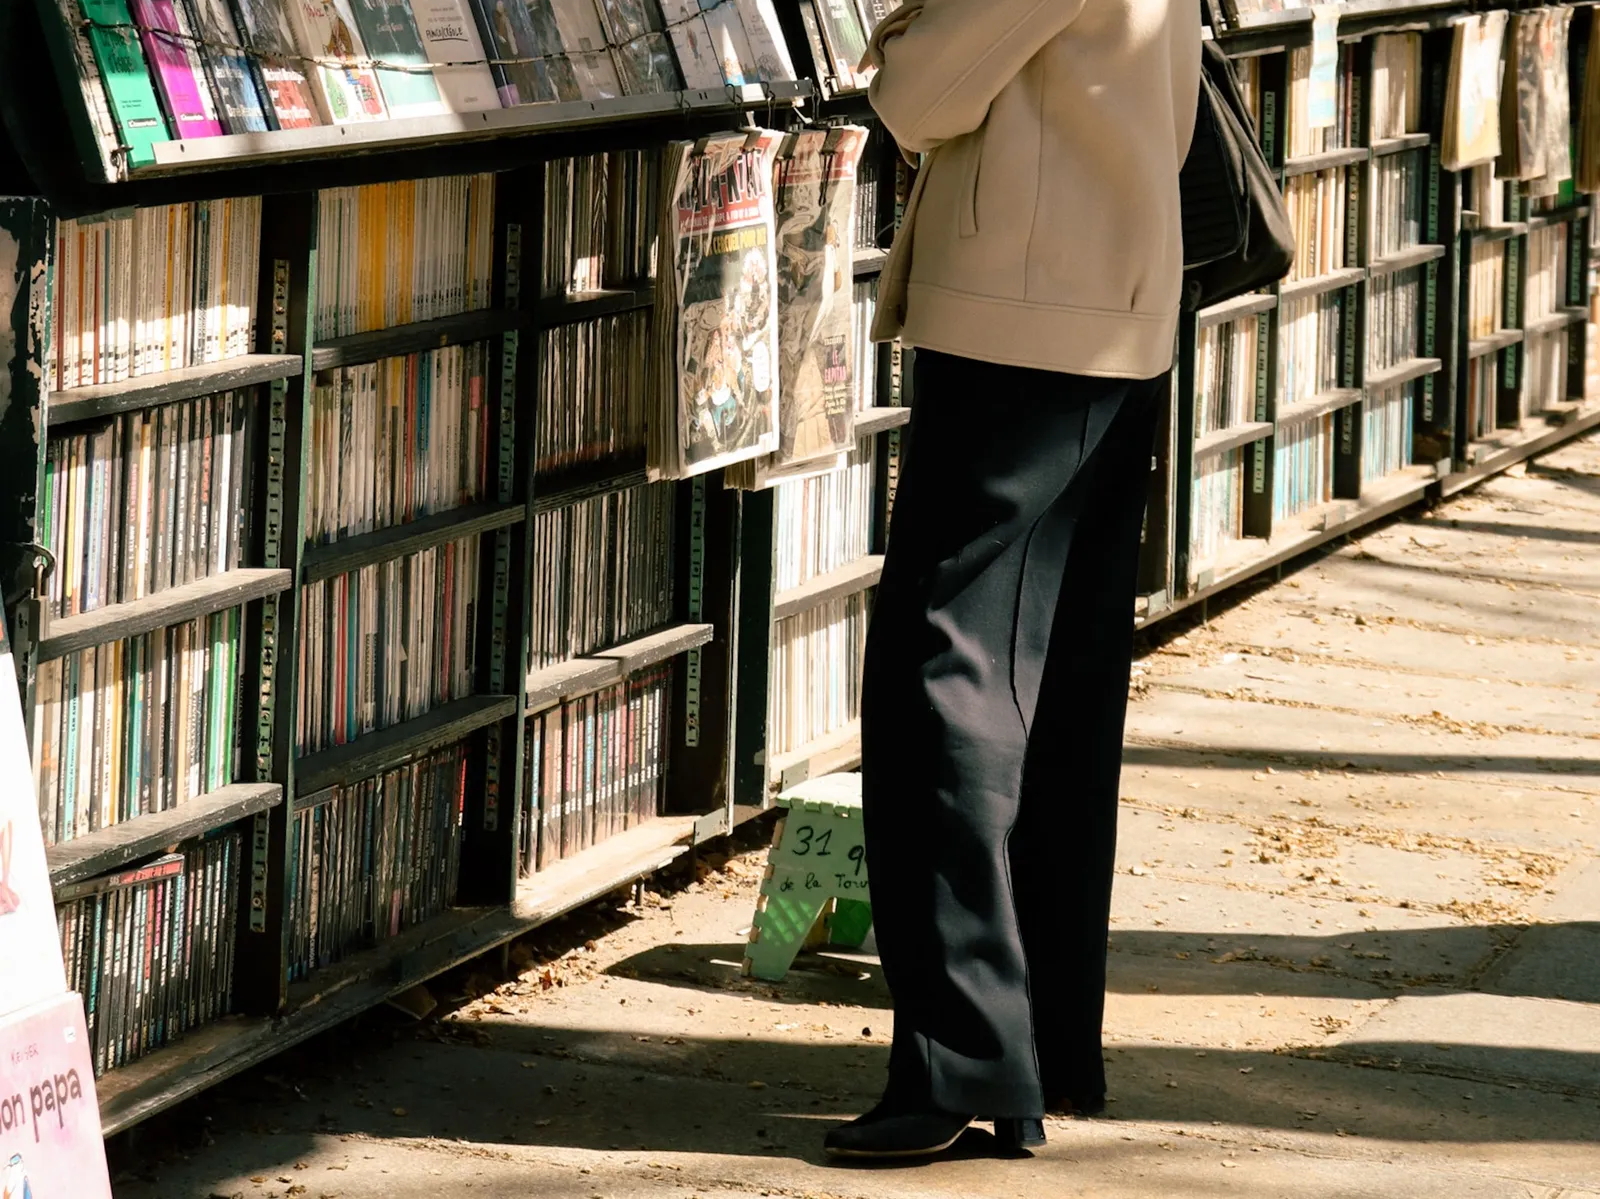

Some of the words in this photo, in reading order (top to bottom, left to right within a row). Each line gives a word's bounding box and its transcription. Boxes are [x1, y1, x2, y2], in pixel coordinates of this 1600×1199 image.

[792, 825, 833, 856] 31
[780, 877, 794, 892] de
[805, 872, 822, 890] la
[30, 1068, 82, 1143] papa
